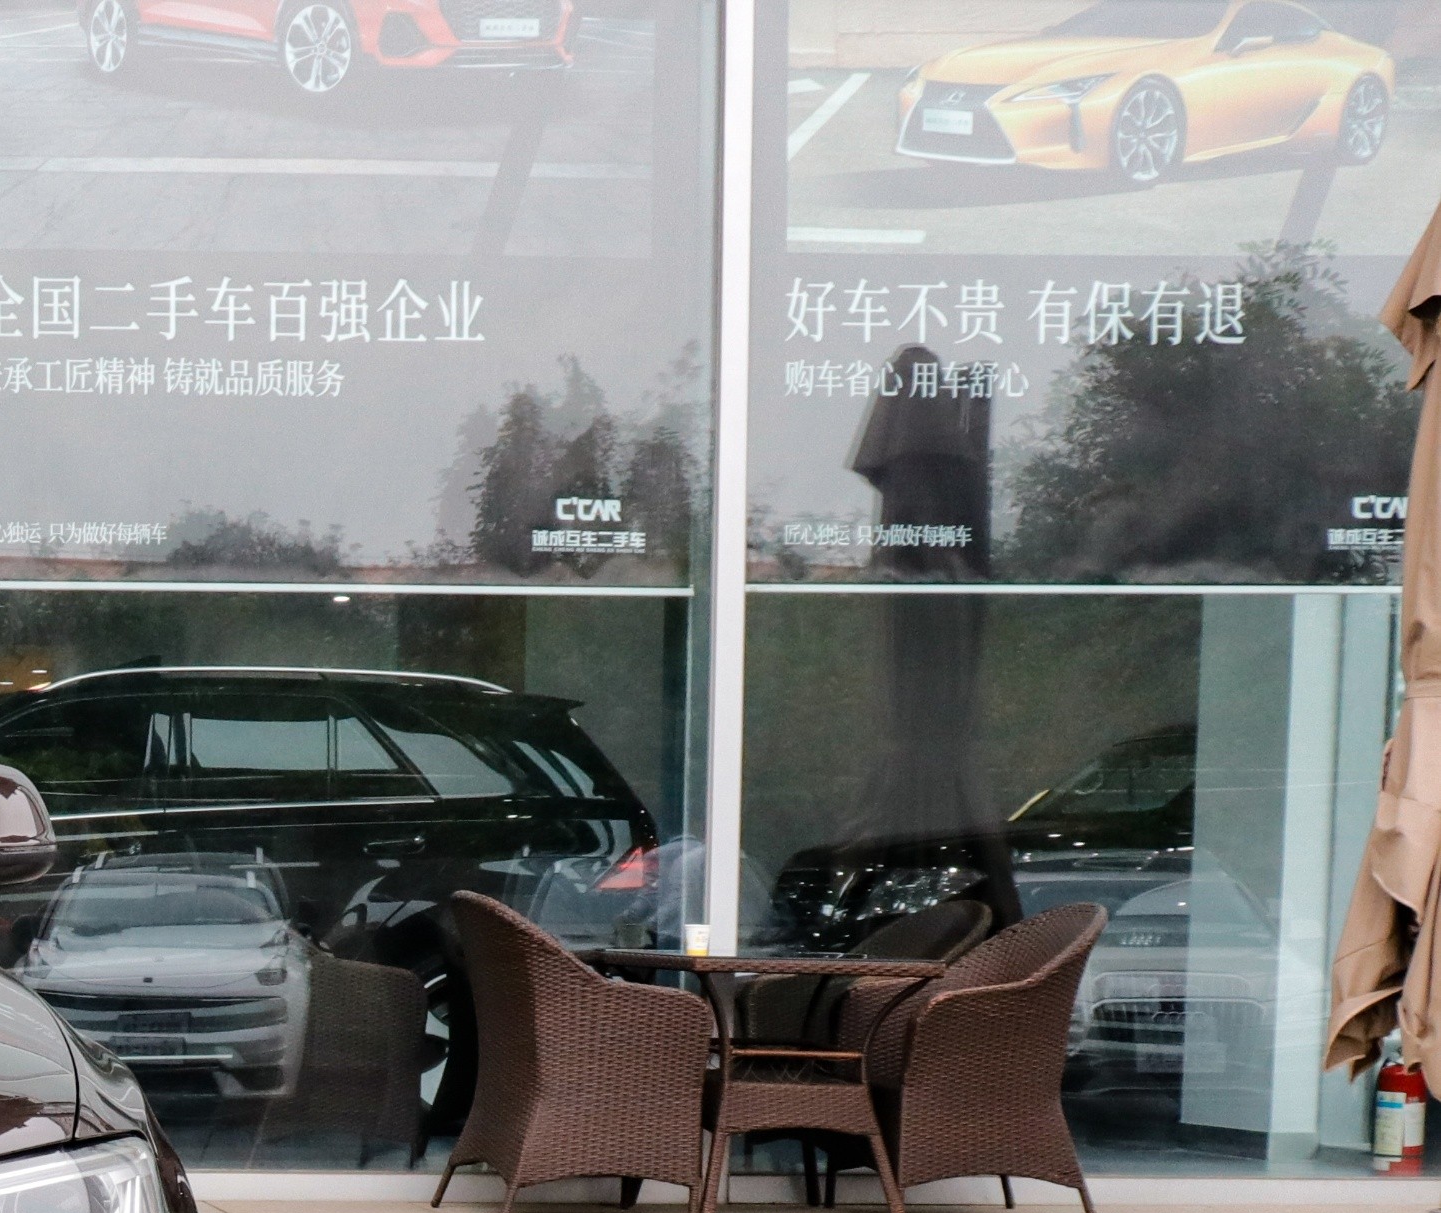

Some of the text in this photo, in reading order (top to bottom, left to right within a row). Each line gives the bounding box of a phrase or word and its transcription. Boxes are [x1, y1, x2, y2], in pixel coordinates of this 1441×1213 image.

[784, 277, 1248, 346] 好车不贵 有保有退
[163, 357, 346, 397] 铸就品质服务
[784, 359, 1030, 399] 购车省心 用车舒心
[48, 521, 168, 545] 只为做好每辆车
[531, 530, 647, 548] 诚成互生二手车
[784, 523, 973, 548] 匠心独运 只为做好每辆车
[1327, 528, 1406, 545] 诚成互生二
